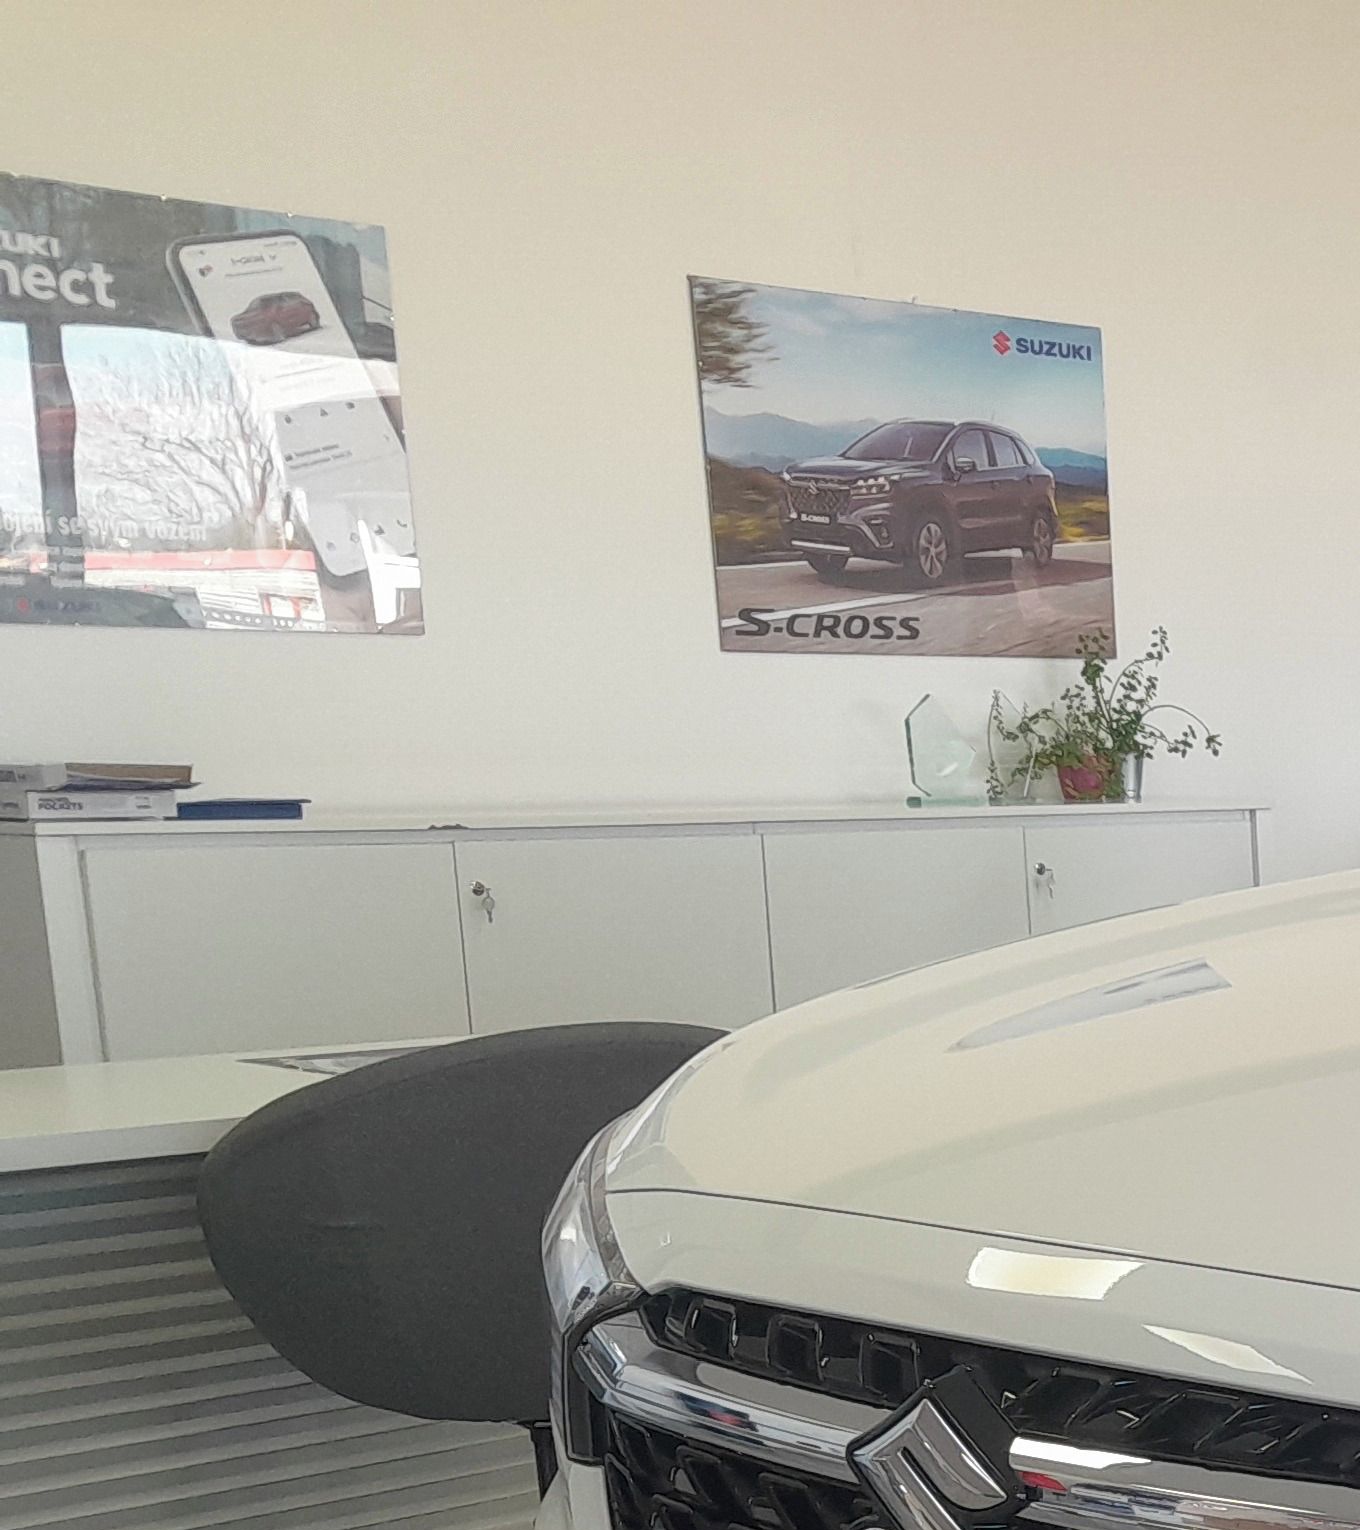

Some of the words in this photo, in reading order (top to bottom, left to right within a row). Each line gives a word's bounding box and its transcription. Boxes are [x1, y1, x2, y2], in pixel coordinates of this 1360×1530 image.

[0, 229, 60, 259] UKI
[1015, 337, 1093, 362] SUZUKI
[735, 607, 921, 641] S-CROSS
